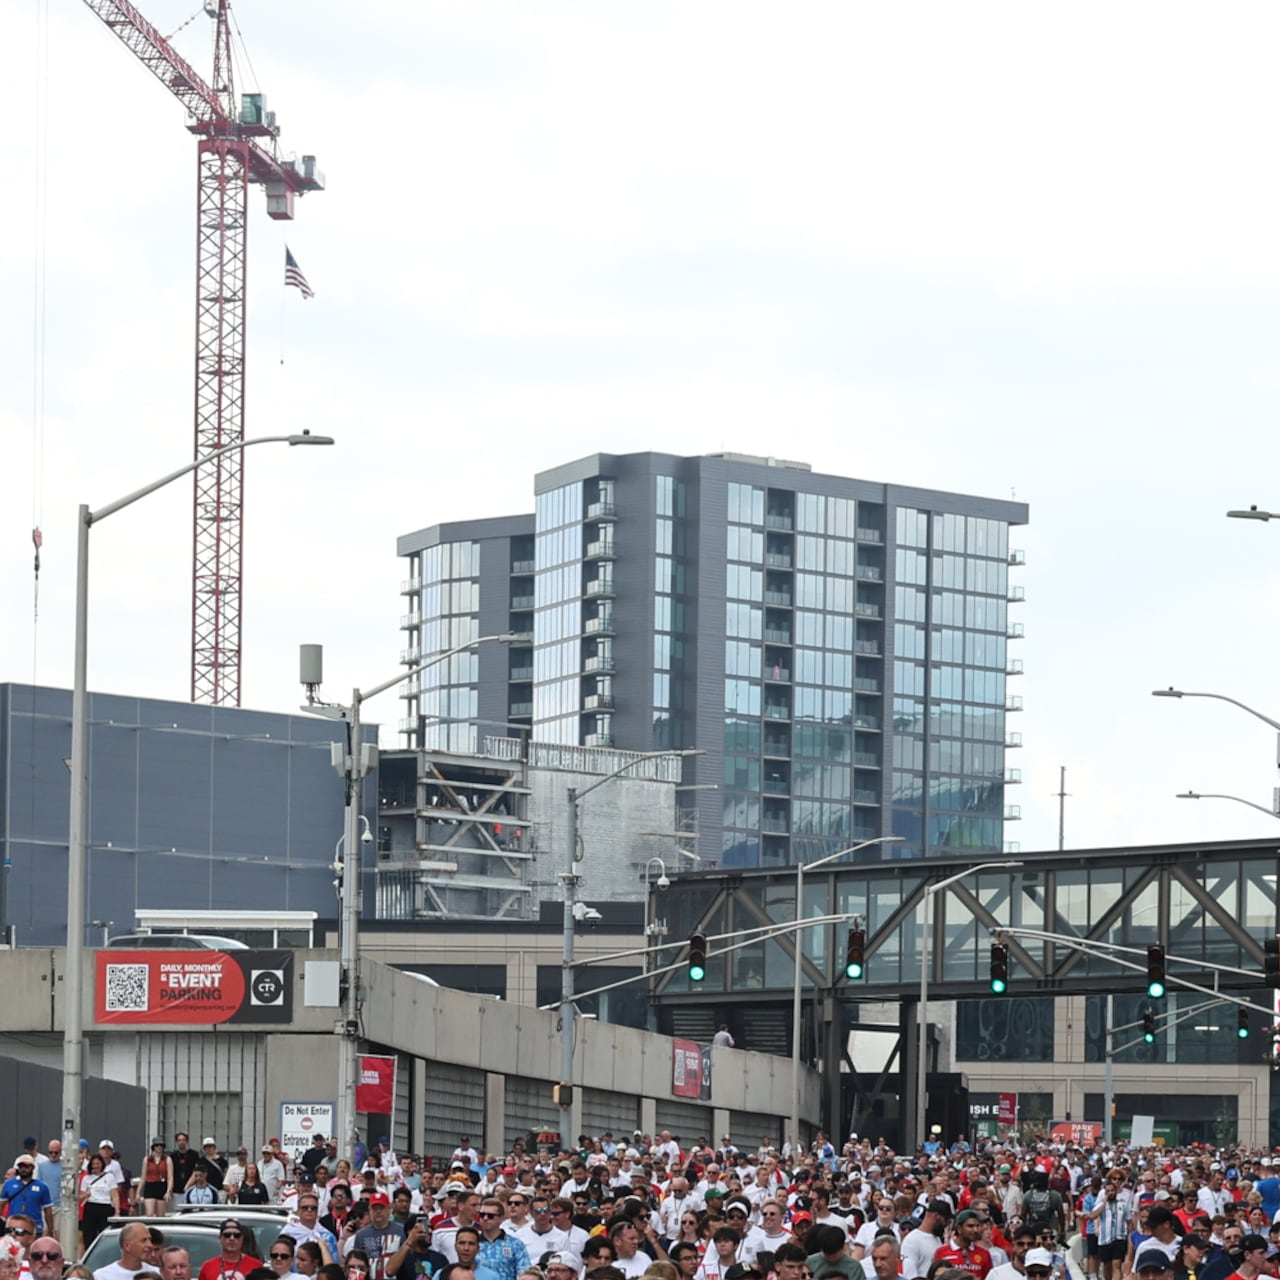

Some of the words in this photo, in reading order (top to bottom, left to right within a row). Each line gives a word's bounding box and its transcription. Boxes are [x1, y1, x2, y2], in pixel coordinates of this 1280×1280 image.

[160, 964, 183, 973] DAILY,
[184, 964, 222, 973] MONTHLY
[169, 974, 223, 988] EVENT
[258, 983, 276, 993] CTR
[160, 989, 221, 1001] PARKING
[284, 1106, 294, 1116] Do
[296, 1106, 309, 1116] Not
[311, 1106, 329, 1116] Enter
[284, 1134, 309, 1146] Entrance
